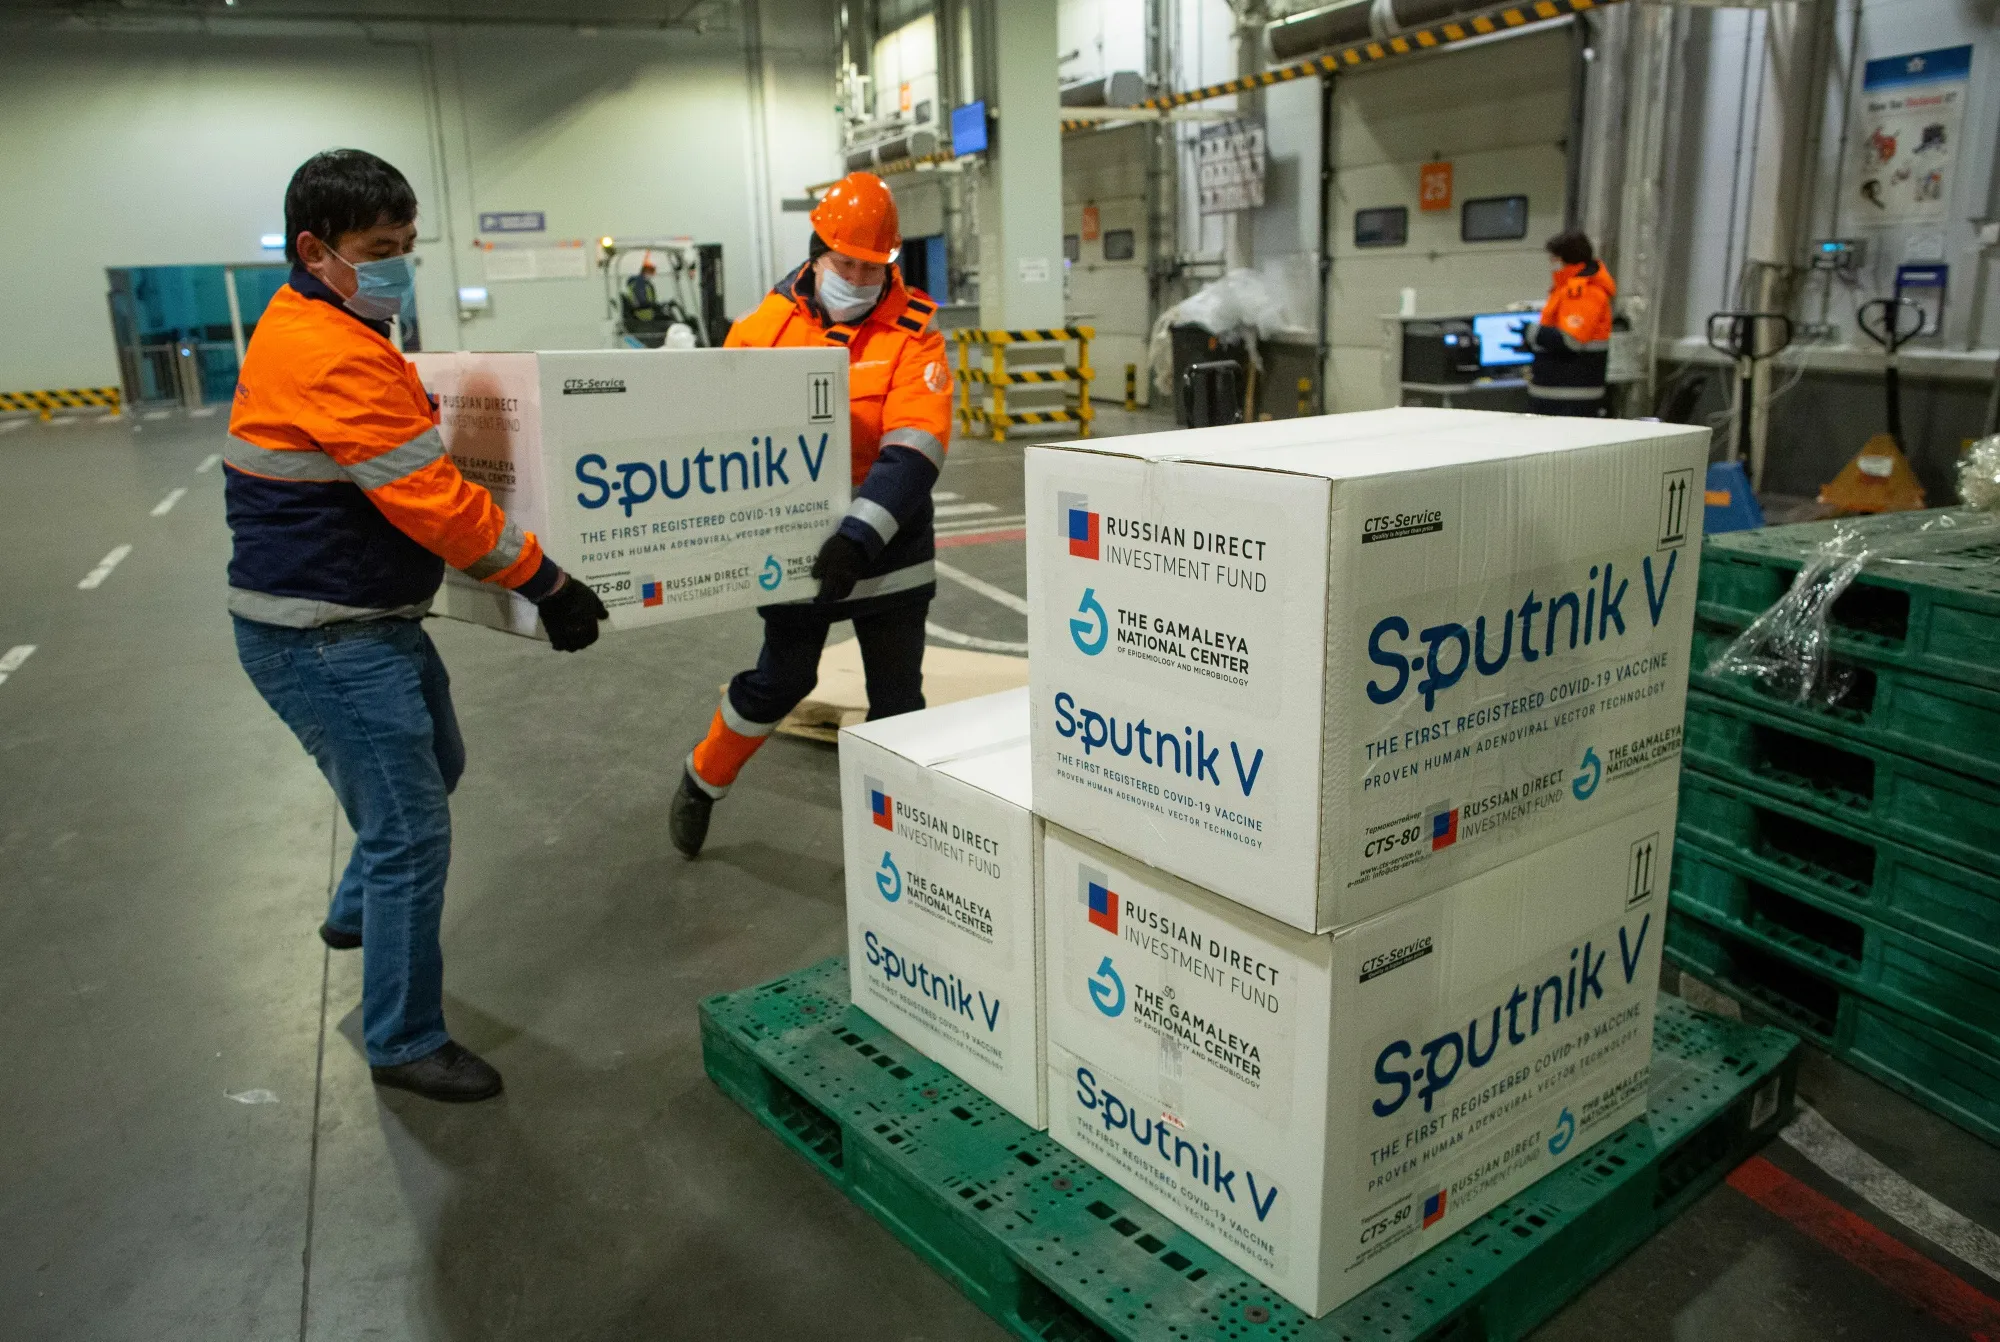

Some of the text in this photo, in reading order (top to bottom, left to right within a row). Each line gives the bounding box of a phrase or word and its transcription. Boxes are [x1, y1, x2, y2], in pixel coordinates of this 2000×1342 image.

[443, 395, 518, 412] RUSSIAN DIRECT
[564, 378, 624, 388] CTS-Service
[471, 458, 515, 473] GAMALEYA
[488, 472, 516, 485] CENTER
[575, 432, 829, 518] Sputnik V
[581, 500, 829, 544] THE FIRST REGISTERED COVID-19 VACCINE
[581, 519, 830, 563] PROVEN HUMAN ADENOVIRAL VECTOR TECHNOLOGY
[1107, 517, 1266, 561] RUSSIAN DIRECT
[1364, 509, 1441, 532] CTS-Service
[666, 567, 749, 590] RUSSIAN DIRECT
[787, 557, 803, 566] THE
[1107, 545, 1267, 593] INVESTMENT FUND
[667, 579, 751, 604] INVESTMENT FUND
[1117, 628, 1249, 675] NATIONAL CENTER
[1118, 609, 1248, 655] THE GAMALEYA
[1366, 549, 1677, 712] Sputnik V
[1128, 649, 1175, 667] EPIDEMIOLOGY
[1177, 662, 1191, 672] AND
[1193, 666, 1249, 687] MICROBIOLOGY
[1366, 652, 1668, 760] THE FIRST REGISTERED COVID-19 VACCINE
[1055, 692, 1264, 797] Sputnik V
[1364, 680, 1666, 791] PROVEN HUMAN ADENOVIRAL VECTOR TECHNOLOGY
[1606, 752, 1648, 775] NATIONAL
[1651, 738, 1681, 758] CENTER
[1609, 724, 1681, 761] THE GAMALEYA
[1057, 752, 1263, 832] THE FIRST REGISTERED COVID-19 VACCINE
[1057, 769, 1262, 849] PROVEN HUMAN ADENOVIRAL VECTOR TECHNOLOGY
[1462, 789, 1563, 839] INVESTMENT FUND
[1464, 769, 1563, 819] RUSSIAN DIRECT
[896, 801, 998, 856] RUSSIAN DIRECT
[1364, 825, 1421, 858] CTS-80
[1365, 811, 1422, 835] Термоконтейнер
[897, 821, 1001, 879] INVESTMENT FUND
[906, 871, 992, 921] THE GAMALEYA
[906, 885, 993, 936] NATIONAL CENTER
[1126, 900, 1279, 986] RUSSIAN DIRECT
[1361, 936, 1431, 973] CTS-Service
[865, 930, 1000, 1032] Sputnik V
[1125, 925, 1279, 1014] INVESTMENT FUND
[1135, 984, 1260, 1062] THE GAMALEYA
[1372, 913, 1650, 1117] Sputnik V
[972, 1035, 1002, 1059] VACCINE
[1134, 1001, 1260, 1080] NATIONAL CENTER
[1134, 1016, 1142, 1025] OF
[1192, 1049, 1206, 1060] AND
[1207, 1057, 1260, 1090] MICROBIOLOGY
[1371, 1001, 1641, 1166] THE FIRST REGISTERED COVID-19 VACCINE
[1077, 1067, 1278, 1222] Sputnik V
[1368, 1157, 1417, 1192] PROVEN
[1422, 1131, 1464, 1163] HUMAN
[1468, 1088, 1532, 1135] ADENOVIRAL
[1537, 1063, 1576, 1093] VECTOR
[1077, 1117, 1275, 1256] THE FIRST REGISTERED COVID-19 VACCINE
[1451, 1131, 1540, 1196] RUSSIAN DIRECT
[1076, 1131, 1275, 1270] PROVEN HUMAN ADENOVIRAL VECTOR TECHNOLOGY
[1360, 1204, 1412, 1245] CTS-80
